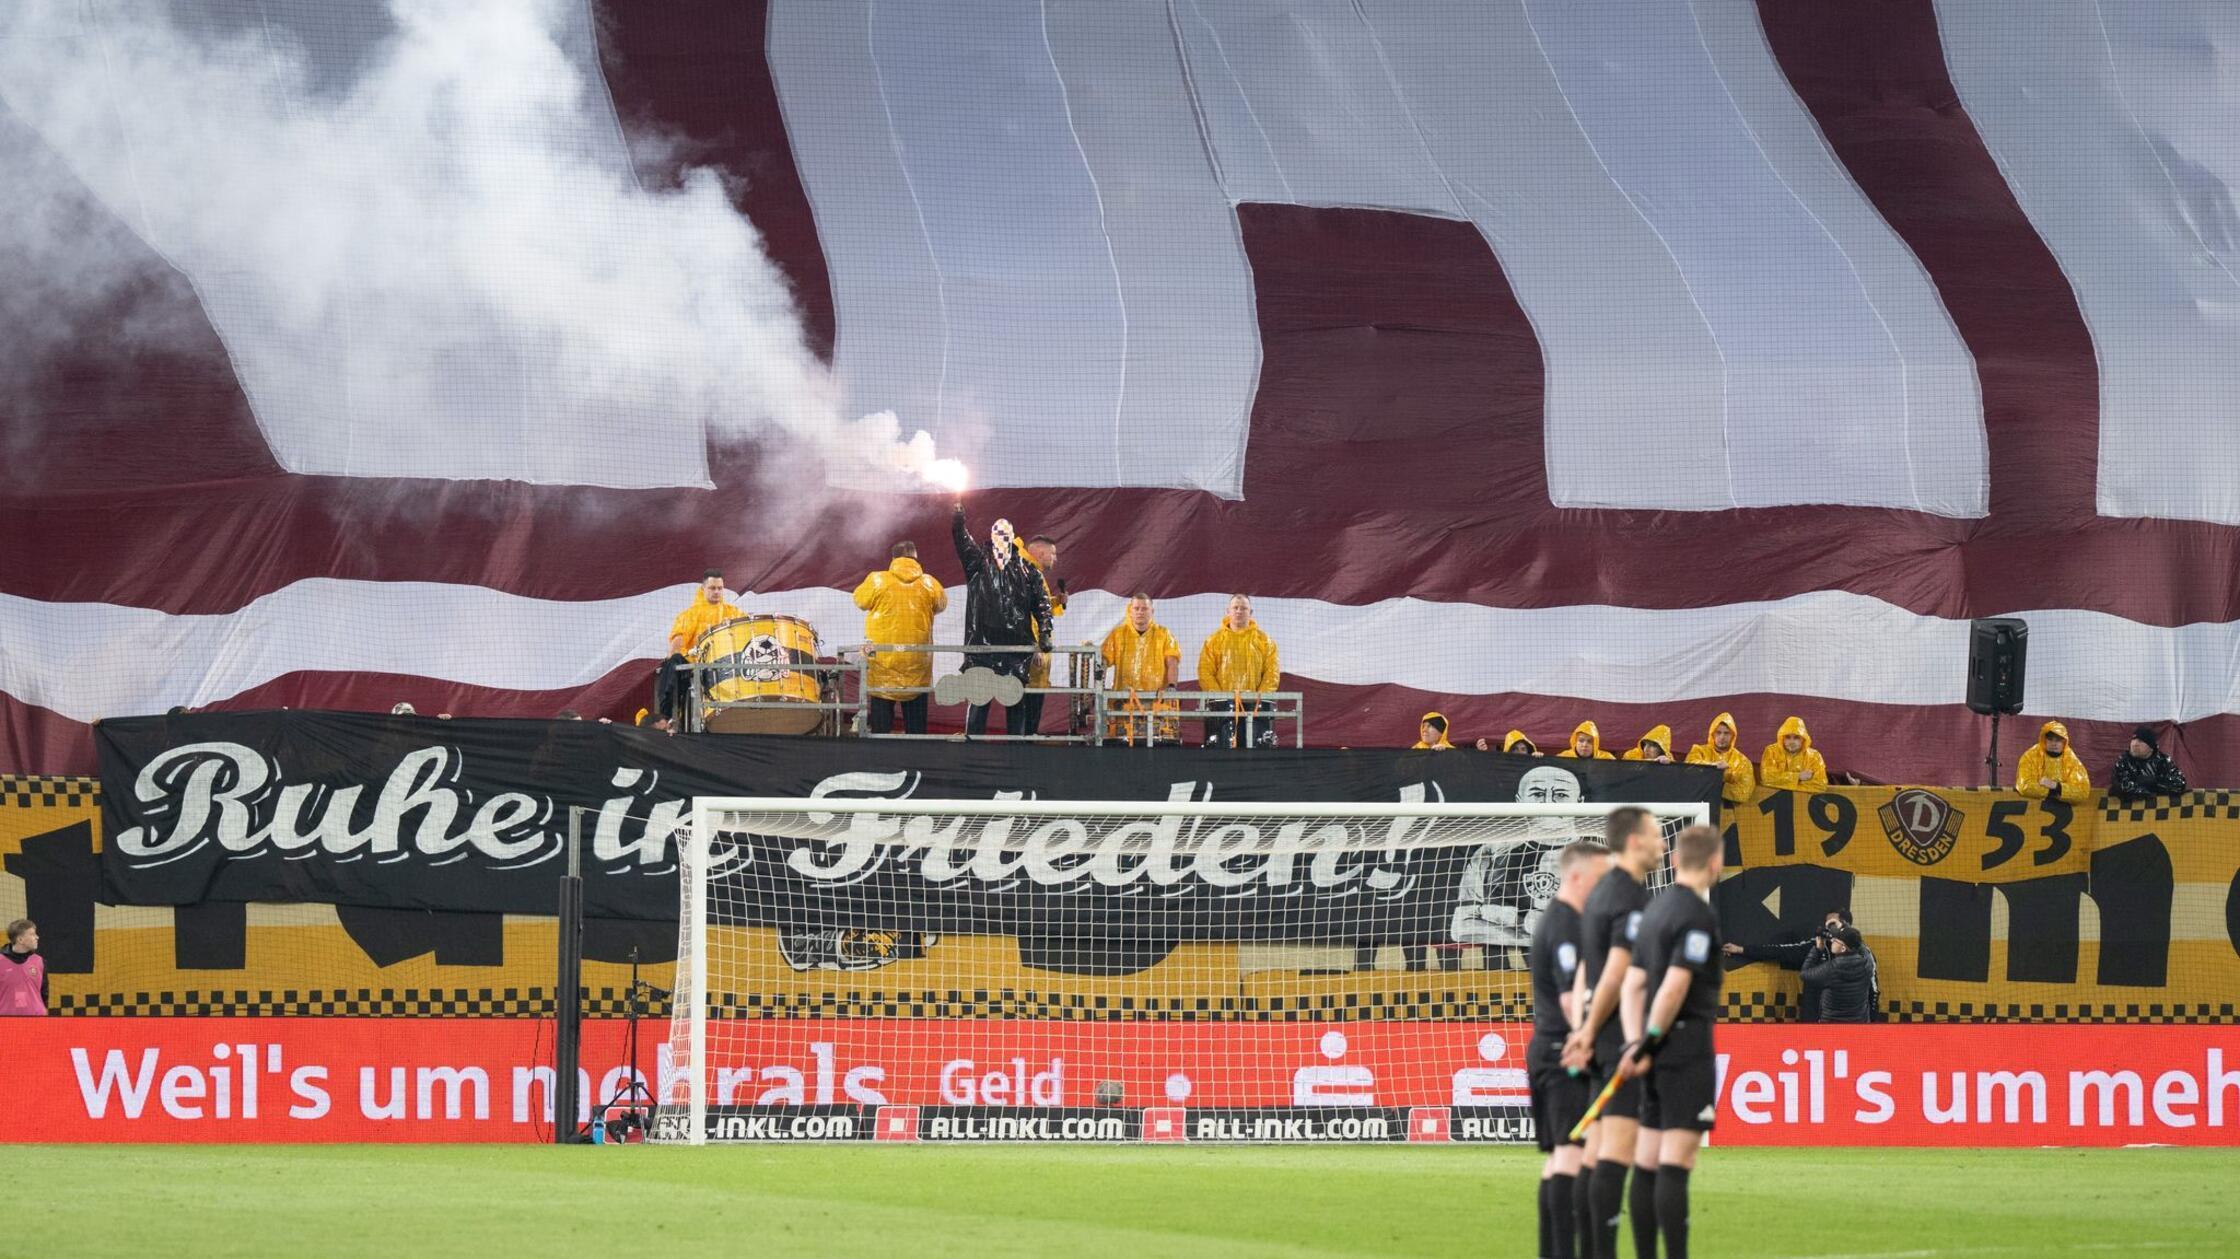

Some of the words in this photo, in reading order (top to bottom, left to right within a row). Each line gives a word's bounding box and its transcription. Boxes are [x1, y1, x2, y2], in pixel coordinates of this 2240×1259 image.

[116, 741, 550, 862] Ruhe
[593, 766, 740, 866] in
[787, 771, 1436, 889] Frieden!
[1758, 789, 1858, 858] 19
[1981, 799, 2075, 871] 53
[1890, 830, 1953, 864] DRESDEN
[70, 1043, 332, 1120] Weil's
[359, 1066, 490, 1120] um
[940, 1058, 1063, 1106] Geld
[1714, 1049, 1896, 1124] eil's
[1922, 1070, 2047, 1125] um
[930, 1117, 1123, 1140] ALL-INKL.COM
[1197, 1118, 1389, 1139] ALL-INKL.COM
